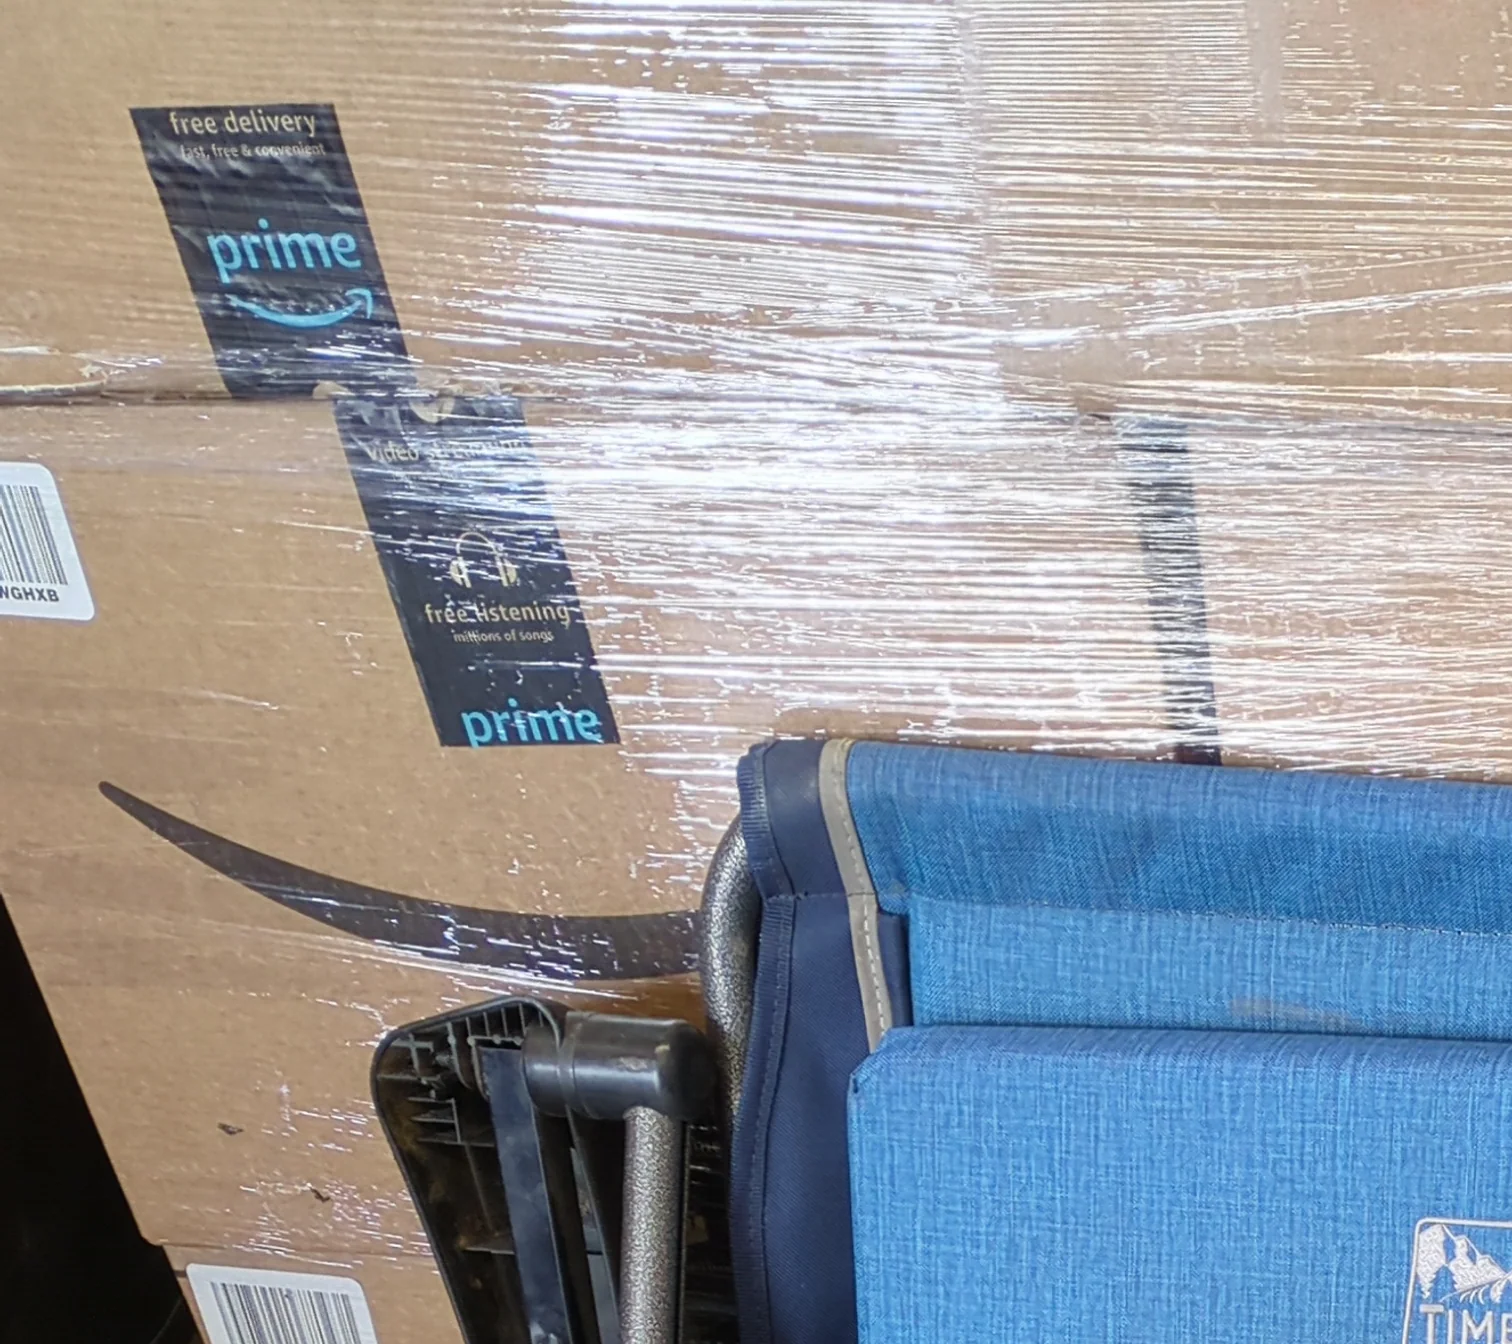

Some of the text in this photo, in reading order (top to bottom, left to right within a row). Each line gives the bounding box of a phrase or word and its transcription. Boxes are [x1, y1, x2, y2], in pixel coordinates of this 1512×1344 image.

[169, 109, 316, 138] free delivery
[211, 144, 239, 158] free
[240, 143, 252, 157] &
[207, 218, 362, 284] prime
[365, 440, 420, 462] video
[424, 600, 572, 629] free listening
[504, 629, 518, 642] of
[519, 630, 555, 644] songs
[461, 697, 603, 748] prime
